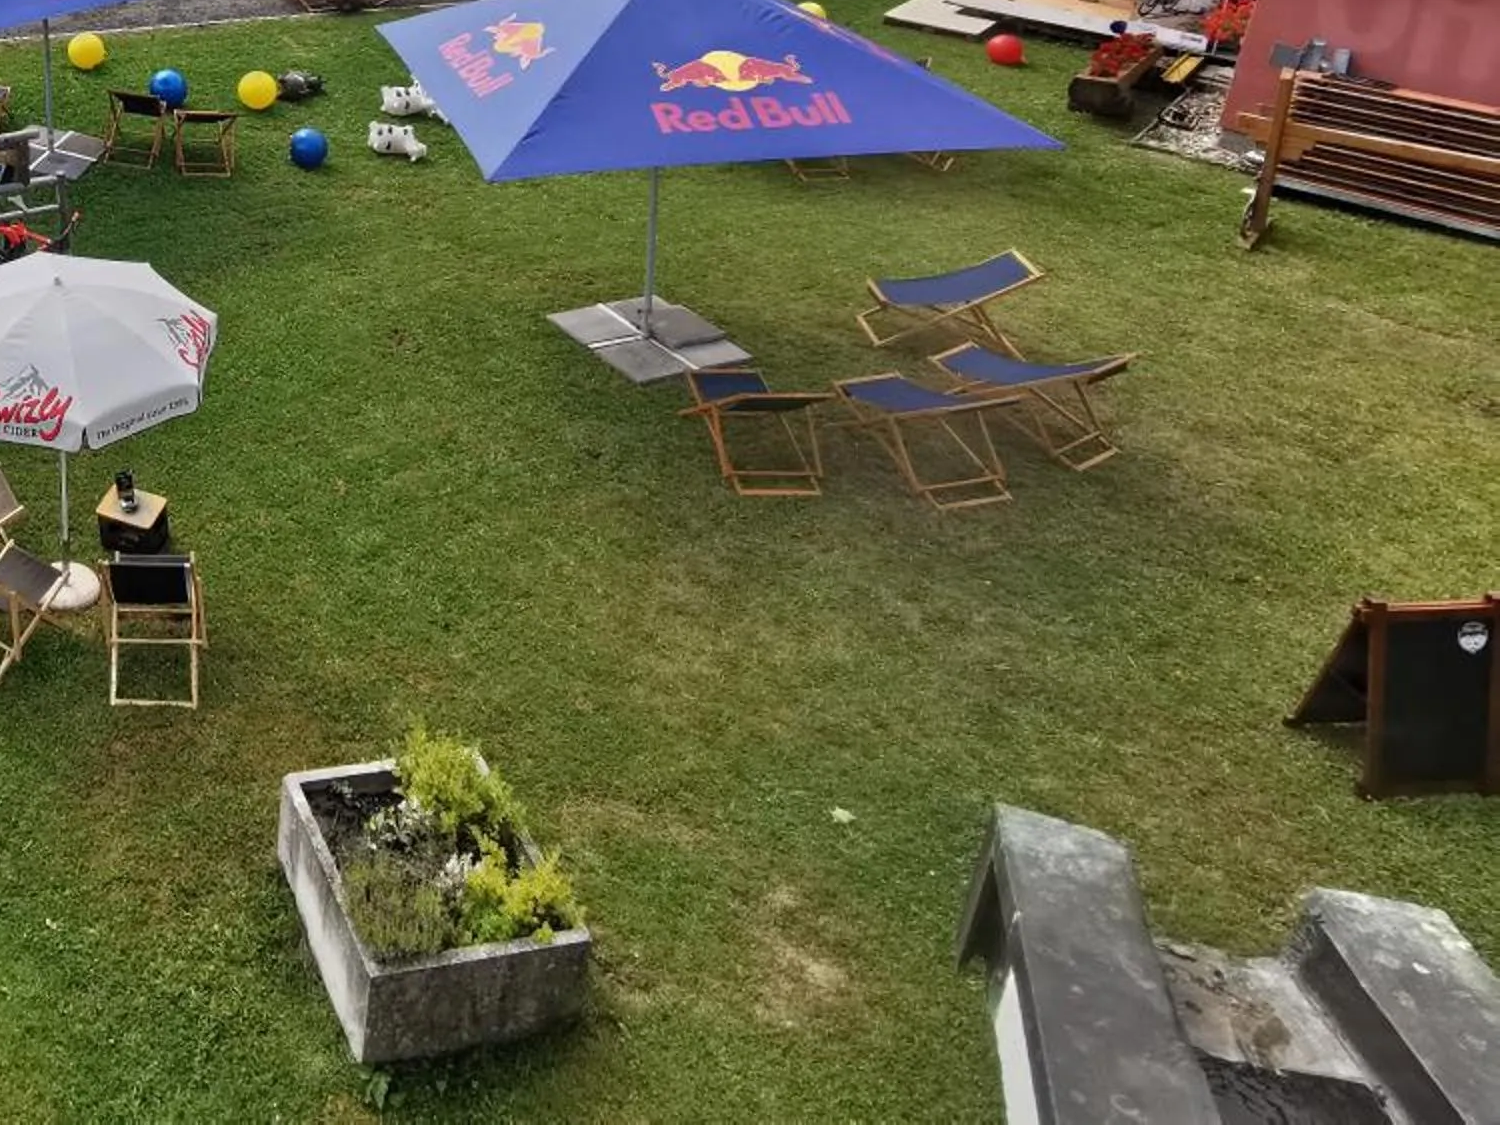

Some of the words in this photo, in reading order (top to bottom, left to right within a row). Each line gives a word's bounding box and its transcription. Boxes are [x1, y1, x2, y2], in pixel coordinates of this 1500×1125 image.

[438, 32, 488, 69] Red
[457, 55, 515, 98] Bull
[650, 96, 753, 134] Red
[751, 91, 851, 127] Bull
